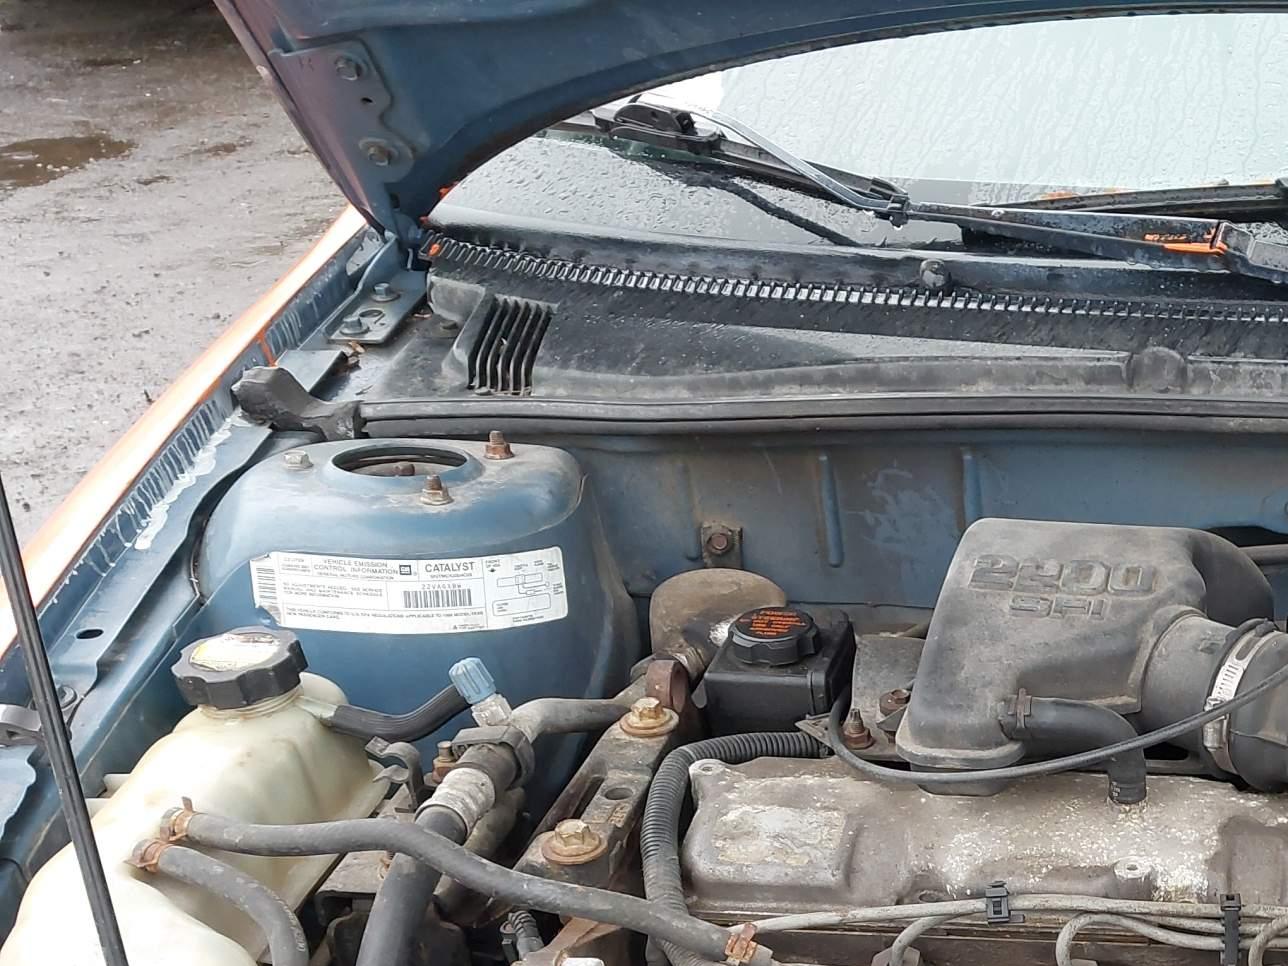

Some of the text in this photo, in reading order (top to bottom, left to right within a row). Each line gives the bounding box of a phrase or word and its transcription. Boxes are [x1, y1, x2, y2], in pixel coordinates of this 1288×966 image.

[354, 560, 388, 568] EMISSION
[424, 561, 475, 573] CATALYST
[350, 567, 398, 575] INFORMATION
[968, 554, 1160, 598] 2200
[1008, 597, 1109, 620] SFI
